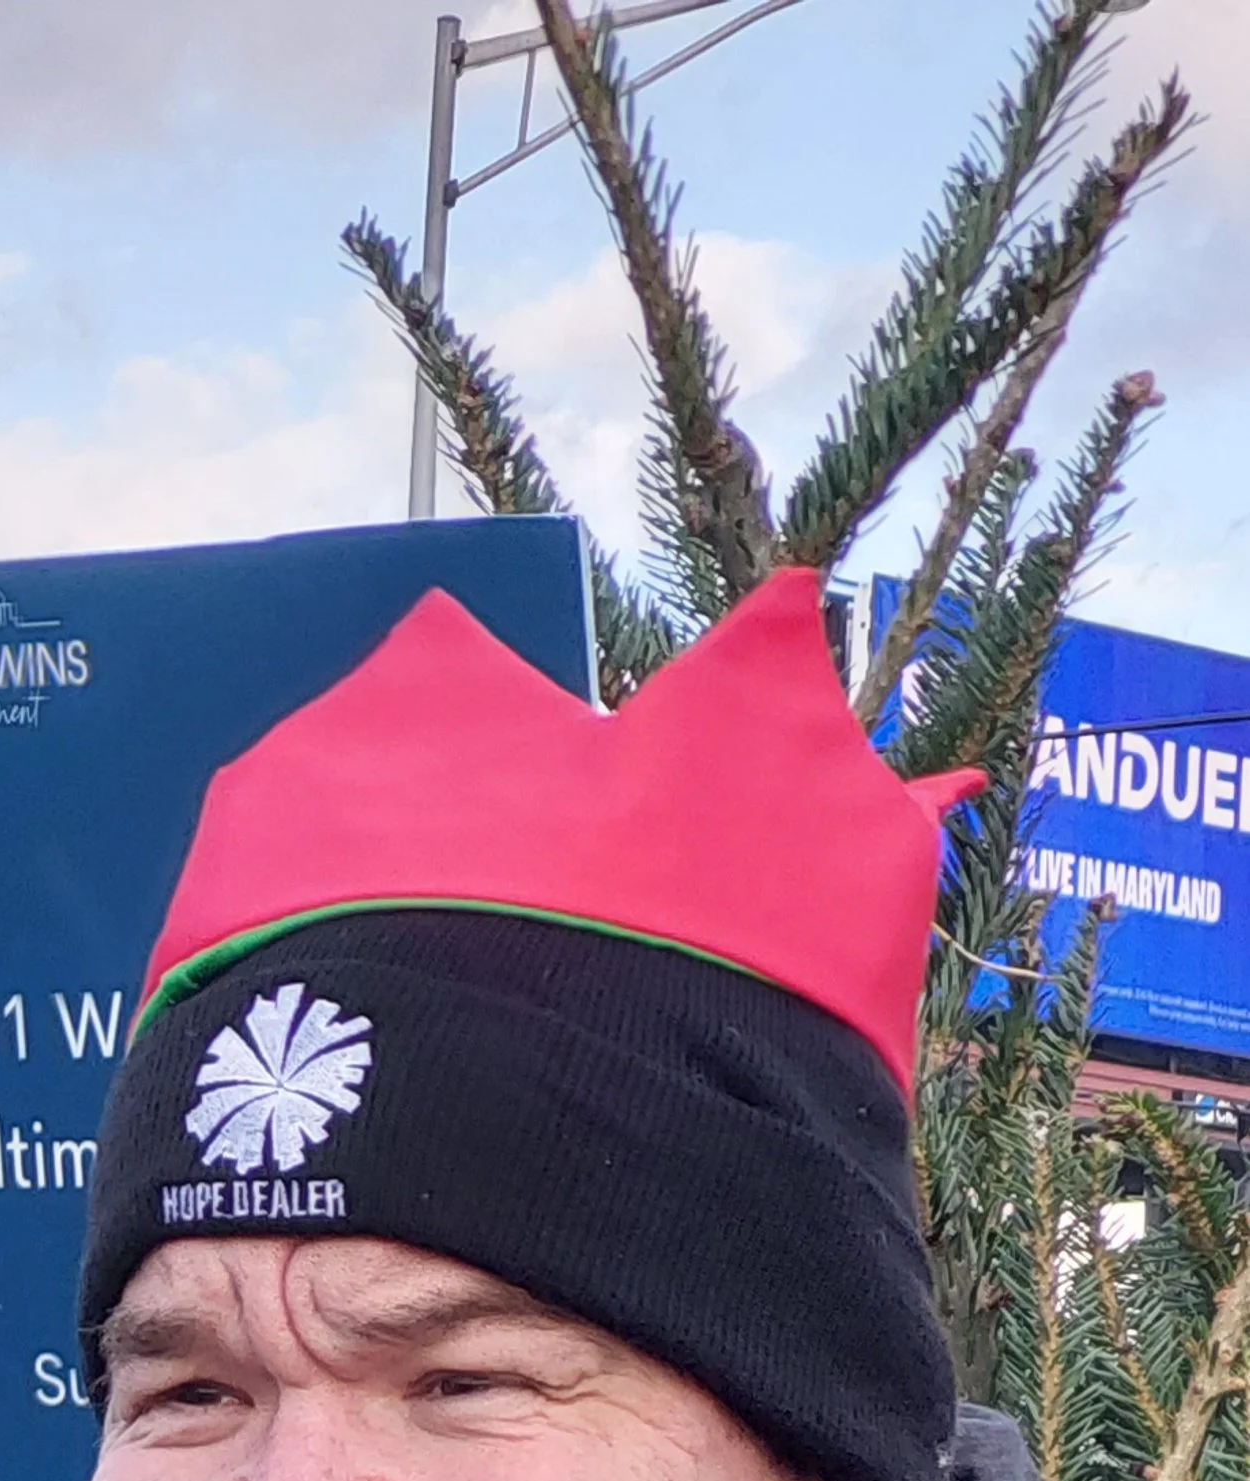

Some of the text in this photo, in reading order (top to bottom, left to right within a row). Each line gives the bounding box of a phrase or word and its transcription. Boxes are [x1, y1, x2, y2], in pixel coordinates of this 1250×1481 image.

[1028, 714, 1250, 833] ANDUE
[1027, 848, 1076, 896] LIVE
[1077, 854, 1103, 899] IN
[1104, 860, 1223, 924] MARYLAND
[53, 990, 123, 1059] W
[162, 1178, 348, 1225] HOPE DEALER
